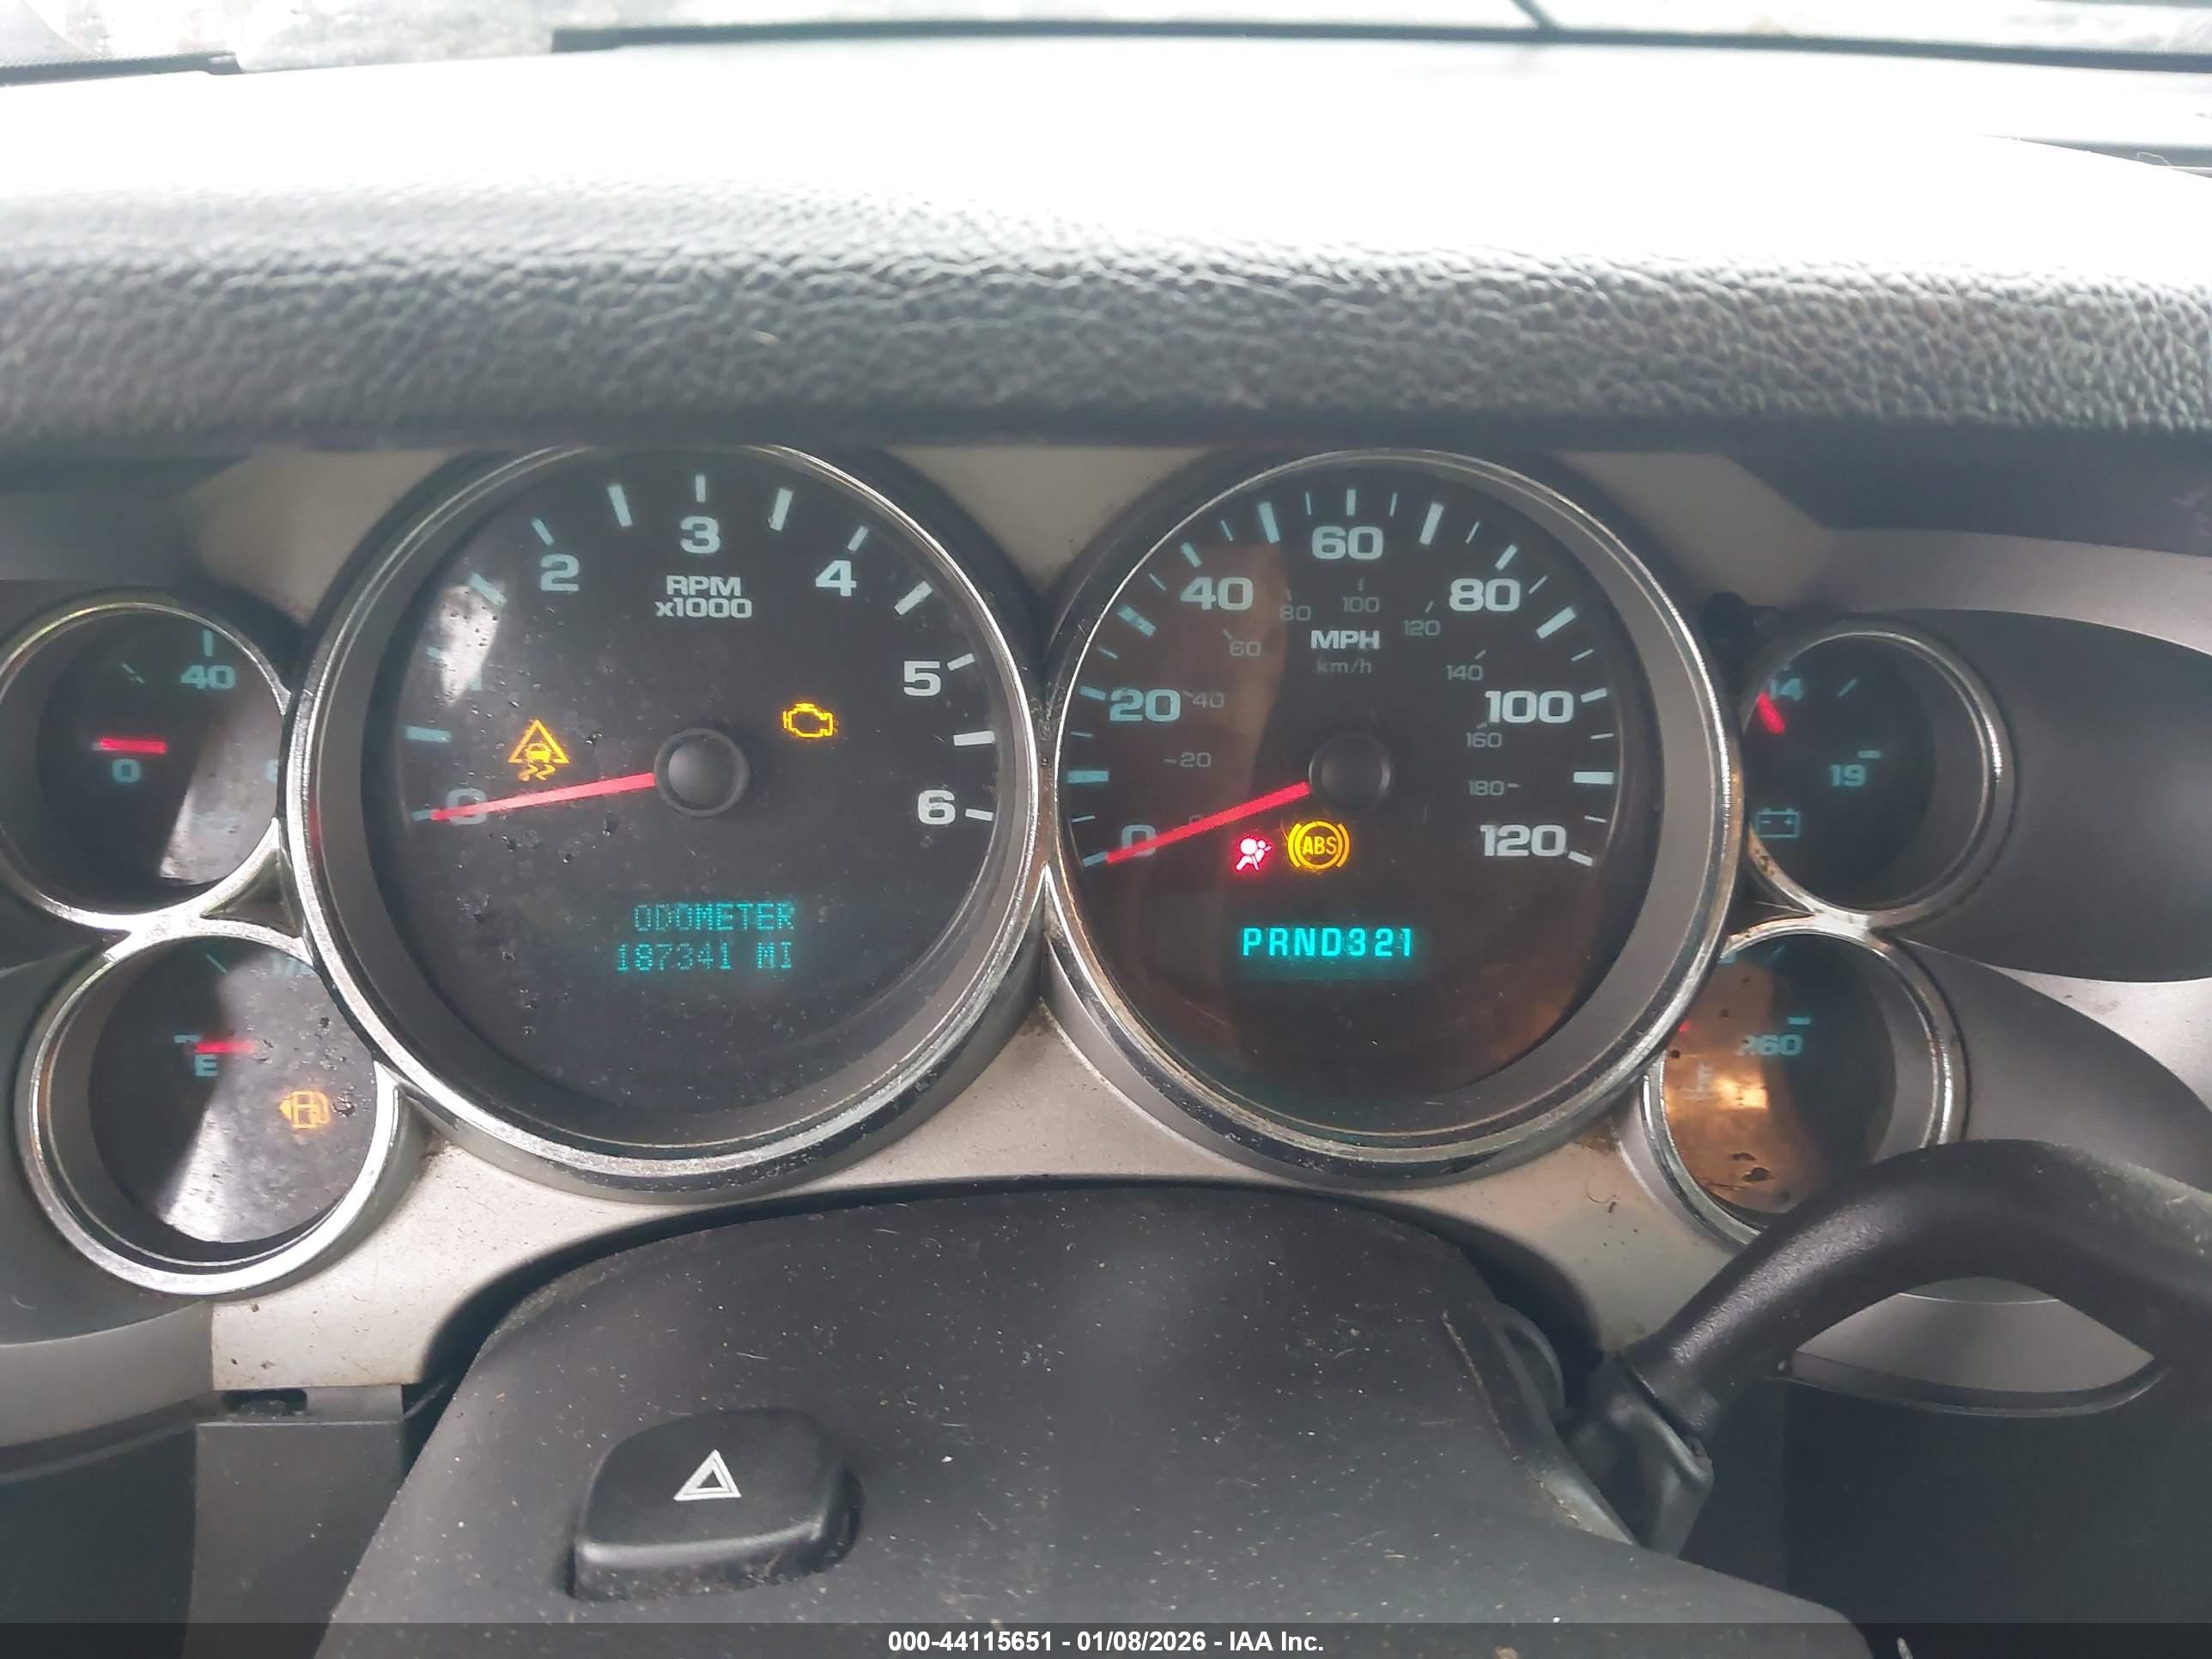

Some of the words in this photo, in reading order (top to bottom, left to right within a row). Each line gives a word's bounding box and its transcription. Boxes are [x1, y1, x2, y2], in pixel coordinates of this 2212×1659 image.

[680, 516, 720, 554] 3
[1311, 526, 1384, 560] 60
[539, 554, 580, 592] 2
[665, 575, 741, 596] RPM
[815, 560, 857, 597] 4
[1180, 576, 1254, 611] 40
[1342, 597, 1381, 613] 100
[1449, 578, 1521, 612] 80
[654, 597, 752, 619] x1000
[1279, 605, 1312, 622] 80
[1310, 630, 1381, 650] MPH
[1404, 619, 1441, 636] 120
[1229, 641, 1262, 658] 60
[179, 664, 235, 690] 40
[1316, 658, 1372, 673] km/h
[1446, 665, 1484, 681] 140
[903, 660, 941, 697] 5
[1109, 688, 1182, 723] 20
[1192, 692, 1224, 708] 40
[1485, 690, 1575, 724] 100
[1466, 732, 1503, 748] 160
[112, 757, 142, 783] 0
[1180, 751, 1212, 769] 20
[1830, 763, 1867, 787] 19
[1468, 780, 1505, 797] 180
[917, 789, 956, 825] 6
[1302, 836, 1337, 856] ABS
[1479, 823, 1567, 858] 120
[634, 902, 794, 932] ODOMETER
[1243, 927, 1413, 957] PRND321
[617, 942, 732, 971] 187341
[757, 941, 793, 969] MI
[194, 1054, 219, 1077] E
